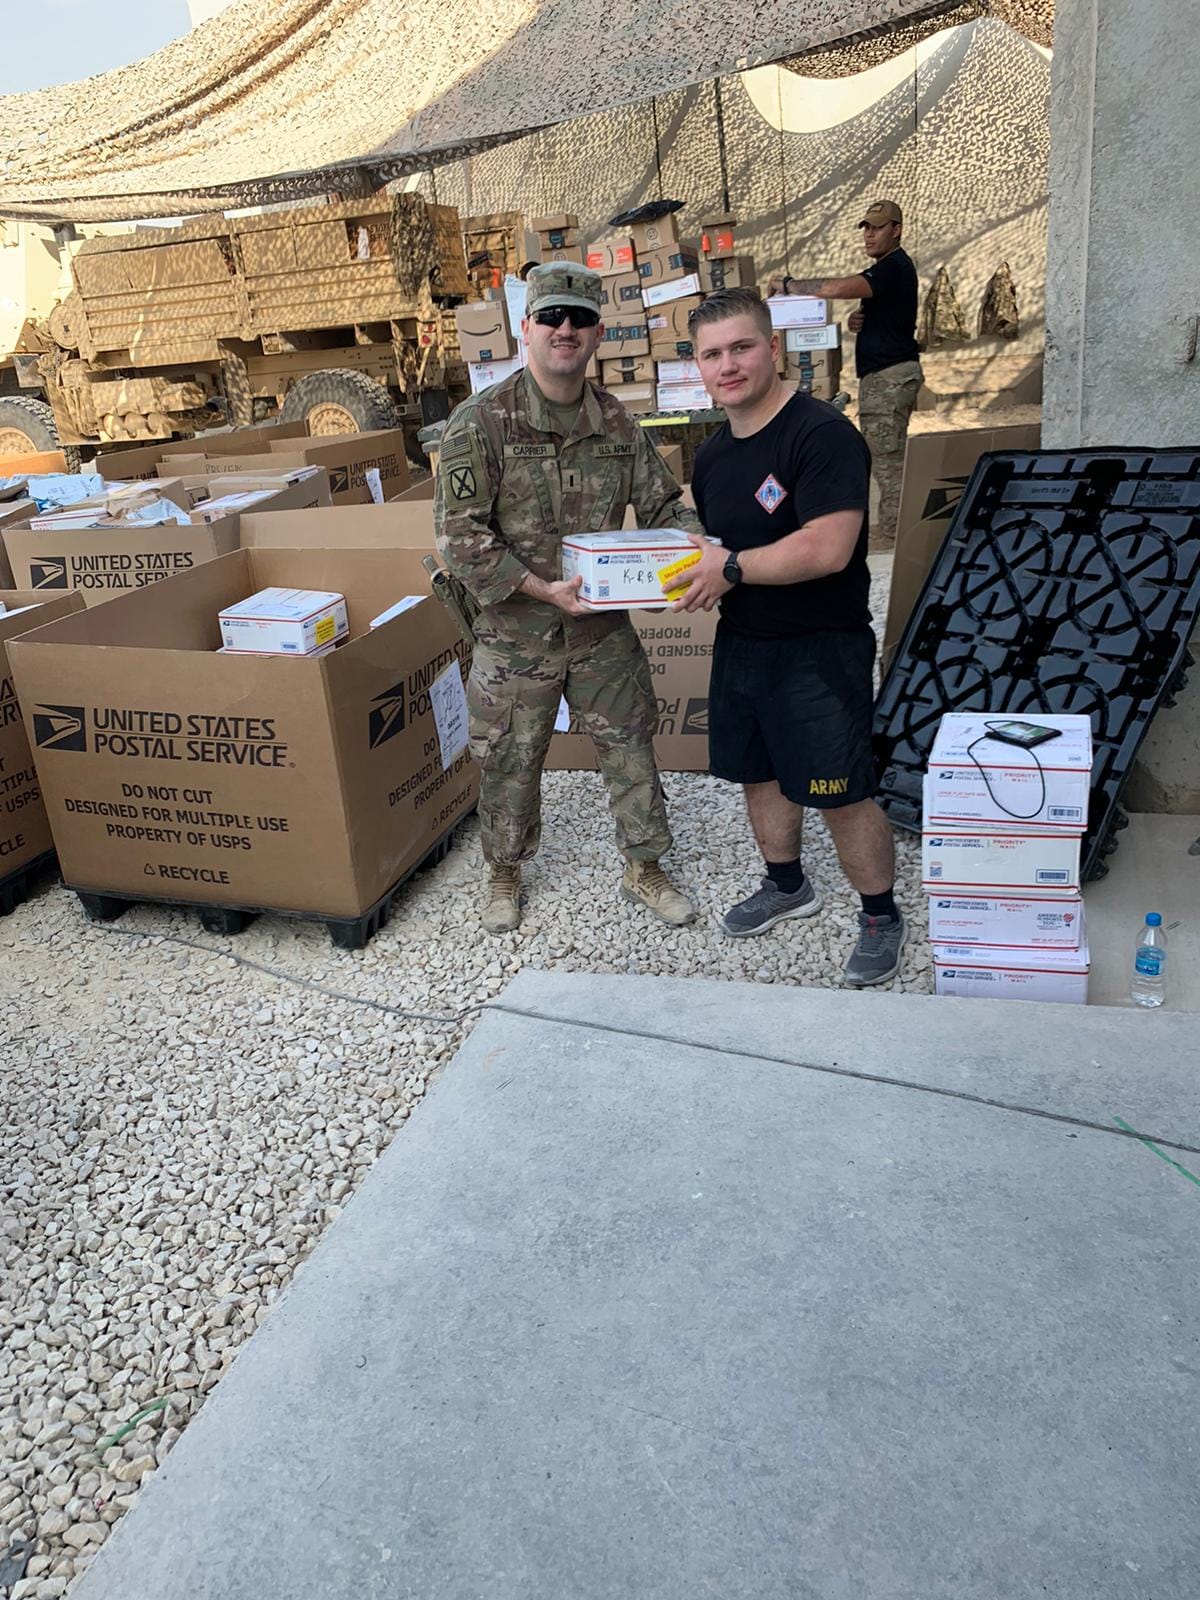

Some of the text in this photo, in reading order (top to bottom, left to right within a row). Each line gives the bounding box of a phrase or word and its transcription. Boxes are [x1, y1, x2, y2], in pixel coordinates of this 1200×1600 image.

[513, 446, 547, 455] CARRIER
[613, 445, 631, 454] ARMY
[350, 459, 376, 475] UNITED
[71, 552, 193, 571] UNITED STATES
[73, 573, 132, 589] POSTAL
[639, 627, 691, 639] PROPER
[657, 644, 714, 657] ESIGNED
[409, 648, 452, 696] UNITED
[93, 708, 276, 740] UNITED STATES
[94, 733, 182, 760] POSTAL
[424, 738, 436, 756] DO
[388, 763, 433, 807] DESIGNED
[414, 755, 465, 809] PROPERTY OF
[809, 777, 849, 795] ARMY
[7, 787, 40, 813] USPS
[122, 784, 212, 804] DO NOT CUT
[440, 784, 471, 823] RECYCLE
[64, 798, 289, 832] DESIGNED FOR MULTIPLE USE
[106, 824, 251, 850] PROPERTY OF USPS
[159, 864, 230, 884] RECYCLE
